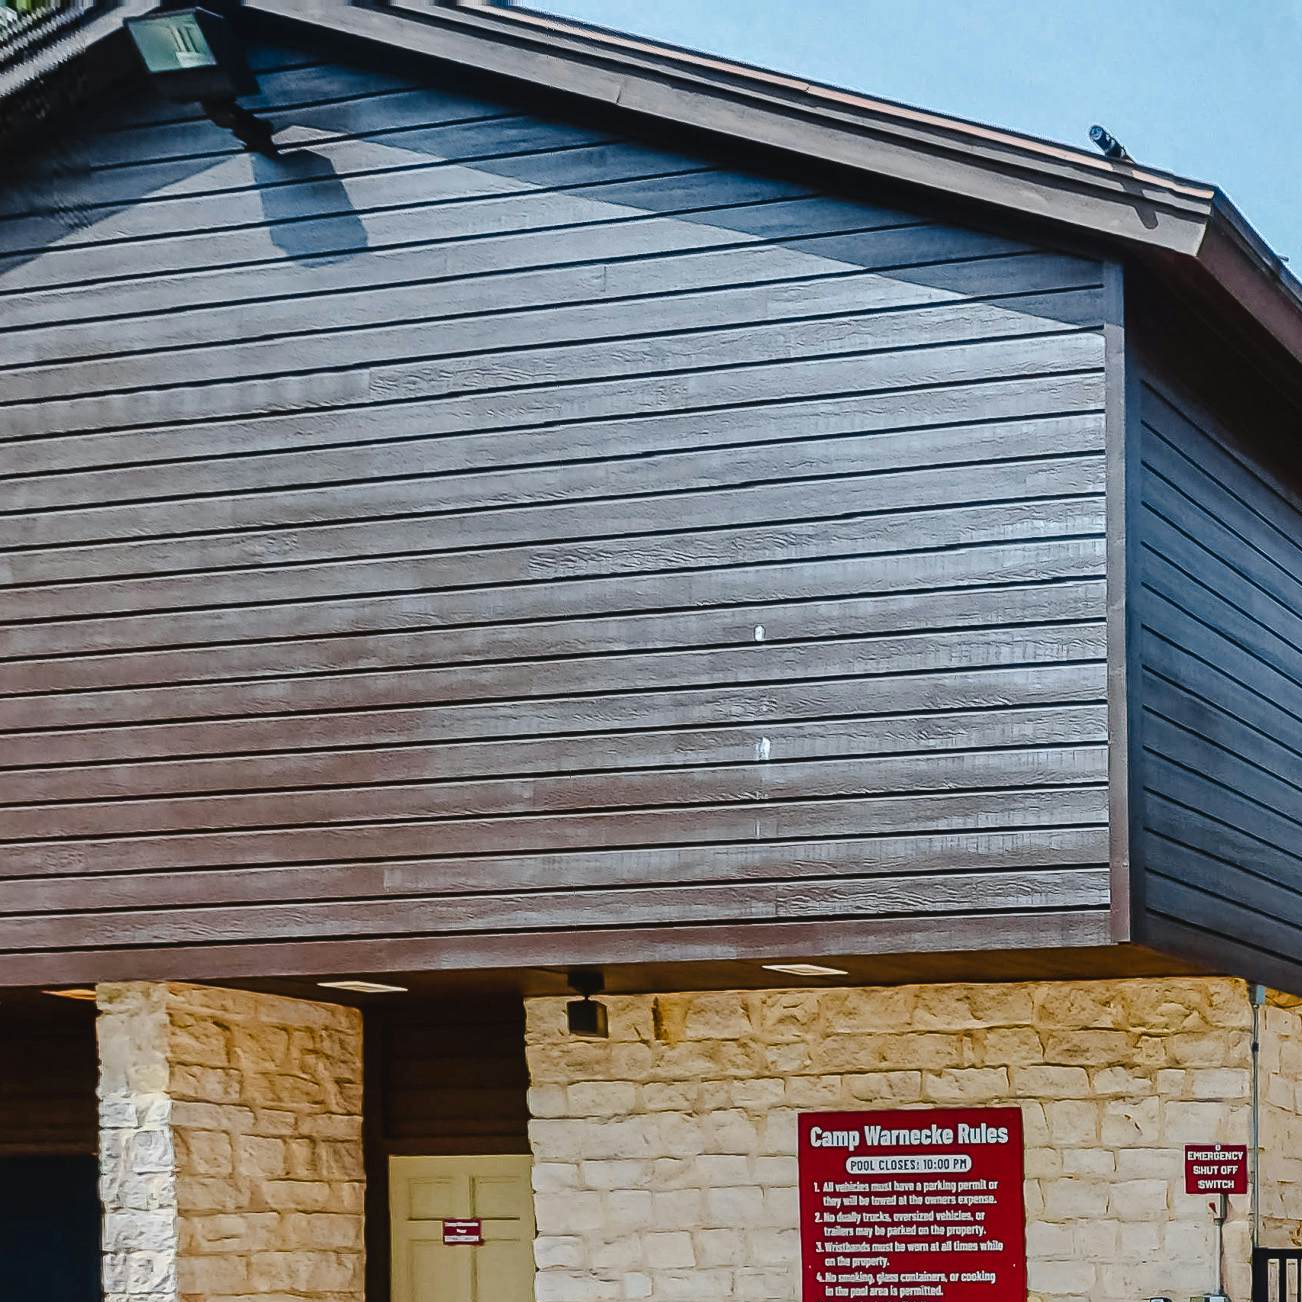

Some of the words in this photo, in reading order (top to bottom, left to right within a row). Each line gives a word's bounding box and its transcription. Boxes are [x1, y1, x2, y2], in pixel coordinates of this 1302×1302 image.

[810, 1126, 860, 1151] Camp
[864, 1124, 953, 1146] Warnecke
[957, 1123, 1008, 1144] Rules
[1187, 1151, 1244, 1160] EMERGENCY
[850, 1160, 874, 1171] POOL
[878, 1159, 920, 1171] CLOSES:
[923, 1159, 949, 1170] 10:00
[953, 1159, 967, 1169] PM
[1193, 1165, 1219, 1175] SHUT
[1220, 1165, 1238, 1175] OFF
[813, 1182, 820, 1192] 1.
[823, 1182, 834, 1192] All
[835, 1181, 869, 1192] vehicles
[871, 1182, 891, 1192] must
[894, 1181, 914, 1191] have
[923, 1180, 956, 1193] parking
[958, 1179, 986, 1191] permit
[988, 1181, 998, 1189] or
[1198, 1180, 1234, 1189] SWITCH
[823, 1196, 841, 1209] they
[843, 1195, 857, 1205] will
[859, 1195, 870, 1205] be
[871, 1195, 896, 1205] towed
[898, 1196, 906, 1205] at
[909, 1195, 922, 1205] the
[925, 1196, 956, 1204] owners
[958, 1195, 997, 1206] expense.
[814, 1212, 823, 1223] 2.
[824, 1212, 835, 1222] No
[893, 1210, 934, 1221] oversized
[936, 1210, 974, 1221] vehicles,
[976, 1212, 985, 1220] or
[824, 1226, 853, 1236] trailers
[855, 1228, 872, 1238] may
[874, 1225, 885, 1235] be
[887, 1225, 916, 1237] parked
[918, 1226, 929, 1235] on
[930, 1225, 945, 1235] the
[946, 1225, 986, 1237] property.
[815, 1242, 824, 1252] 3.
[824, 1242, 870, 1252] Wristbands
[872, 1242, 893, 1252] must
[895, 1241, 906, 1251] be
[907, 1243, 929, 1251] worn
[930, 1242, 939, 1251] at
[941, 1241, 952, 1251] all
[954, 1240, 978, 1251] times
[979, 1240, 1003, 1251] while
[825, 1258, 835, 1266] on
[837, 1256, 850, 1266] the
[852, 1256, 890, 1268] property.
[816, 1272, 825, 1282] 4.
[825, 1272, 836, 1282] No
[838, 1271, 875, 1285] smoking,
[876, 1272, 898, 1285] glass
[900, 1270, 948, 1283] containers,
[949, 1272, 960, 1281] or
[961, 1270, 996, 1284] cooking
[825, 1285, 833, 1296] in
[835, 1286, 848, 1296] the
[850, 1285, 868, 1298] pool
[869, 1287, 888, 1296] area
[890, 1285, 897, 1296] is
[899, 1285, 943, 1298] permitted.
